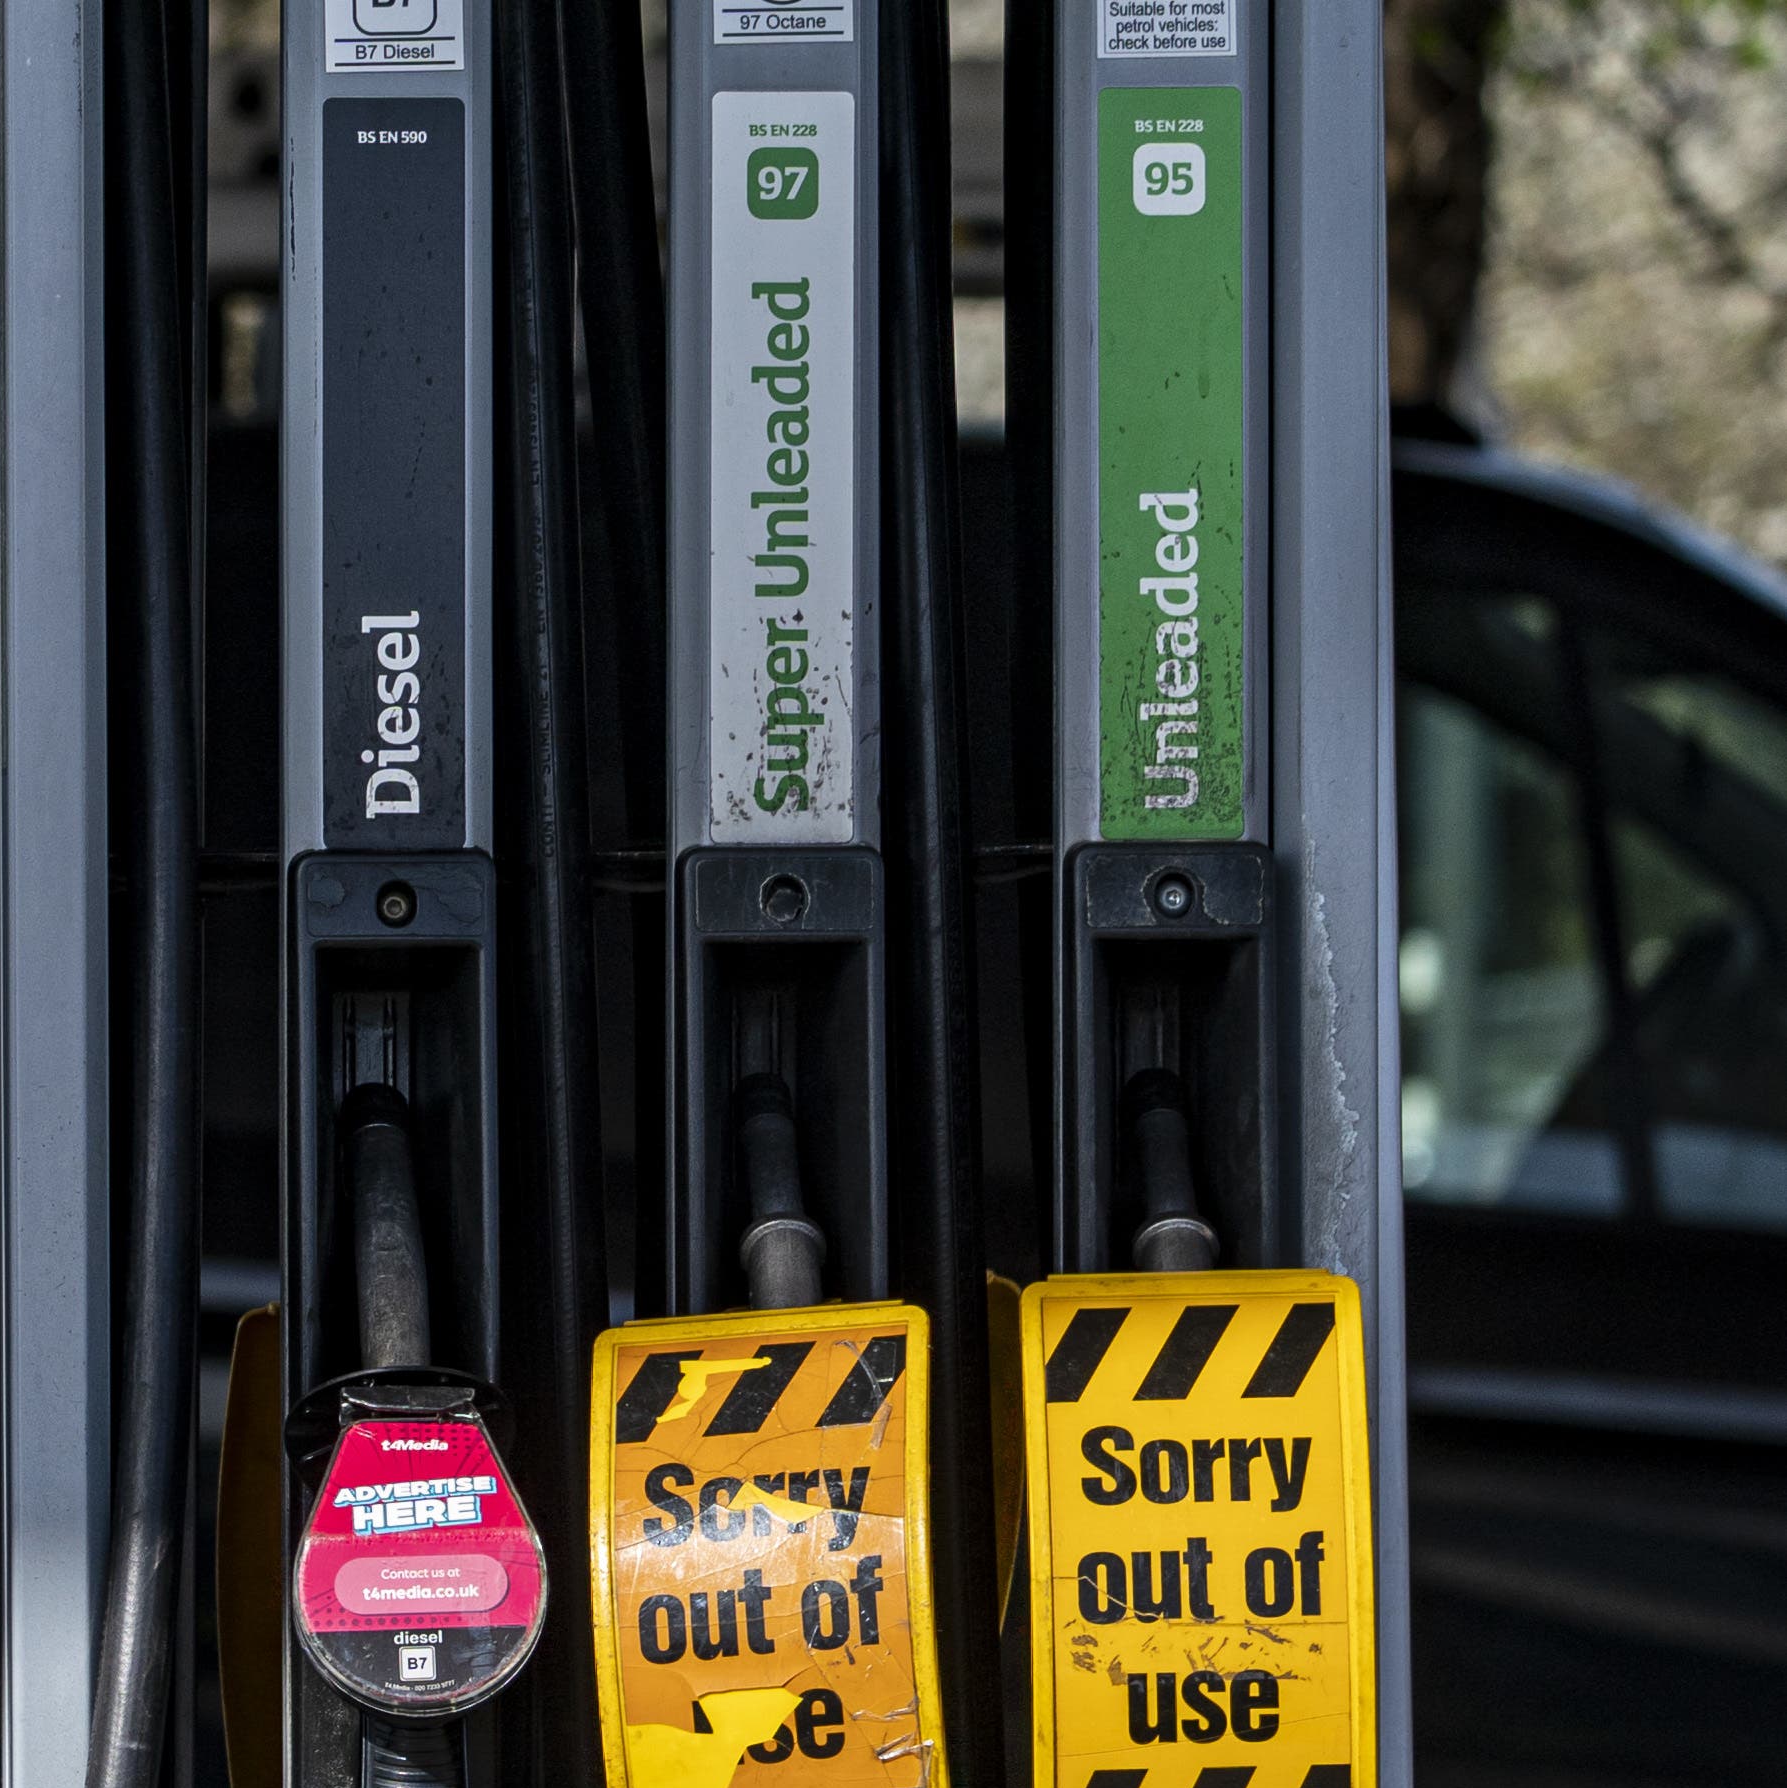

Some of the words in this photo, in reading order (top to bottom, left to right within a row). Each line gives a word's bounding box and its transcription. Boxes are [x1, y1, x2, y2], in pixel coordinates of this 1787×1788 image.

[740, 15, 760, 29] 97
[766, 15, 826, 29] Octane
[1110, 0, 1165, 17] Suitable
[1169, 0, 1186, 15] for
[1191, 1, 1225, 15] most
[1117, 18, 1154, 34] petrol
[355, 46, 377, 59] B7
[384, 44, 434, 59] Diesel
[1109, 35, 1148, 50] check
[1154, 34, 1196, 49] before
[1201, 36, 1225, 48] use
[357, 132, 375, 143] BS
[380, 132, 398, 143] EN
[401, 132, 427, 143] 590
[749, 125, 767, 136] BS
[771, 125, 789, 136] EN
[793, 125, 817, 136] 228
[1135, 120, 1153, 132] BS
[1157, 120, 1175, 132] EN
[1178, 120, 1203, 132] 228
[758, 167, 808, 200] 97
[1145, 162, 1193, 195] 95
[751, 277, 808, 598] Unleaded
[1139, 489, 1198, 811] Unleaded
[361, 611, 420, 820] Diesel
[754, 618, 820, 813] Super
[1079, 1425, 1312, 1512] Sorry
[334, 1476, 497, 1507] ADVERTISE
[352, 1495, 482, 1534] HERE
[642, 1464, 871, 1551] Sorry
[381, 1568, 429, 1580] Contact
[433, 1570, 444, 1579] us
[448, 1568, 460, 1577] at
[1076, 1537, 1215, 1624] out
[1244, 1531, 1325, 1617] of
[363, 1586, 479, 1600] t4media.co.uk
[639, 1567, 774, 1665] out
[801, 1555, 884, 1651] of
[394, 1631, 443, 1645] diesel
[408, 1658, 428, 1669] B7
[1127, 1668, 1280, 1744] use
